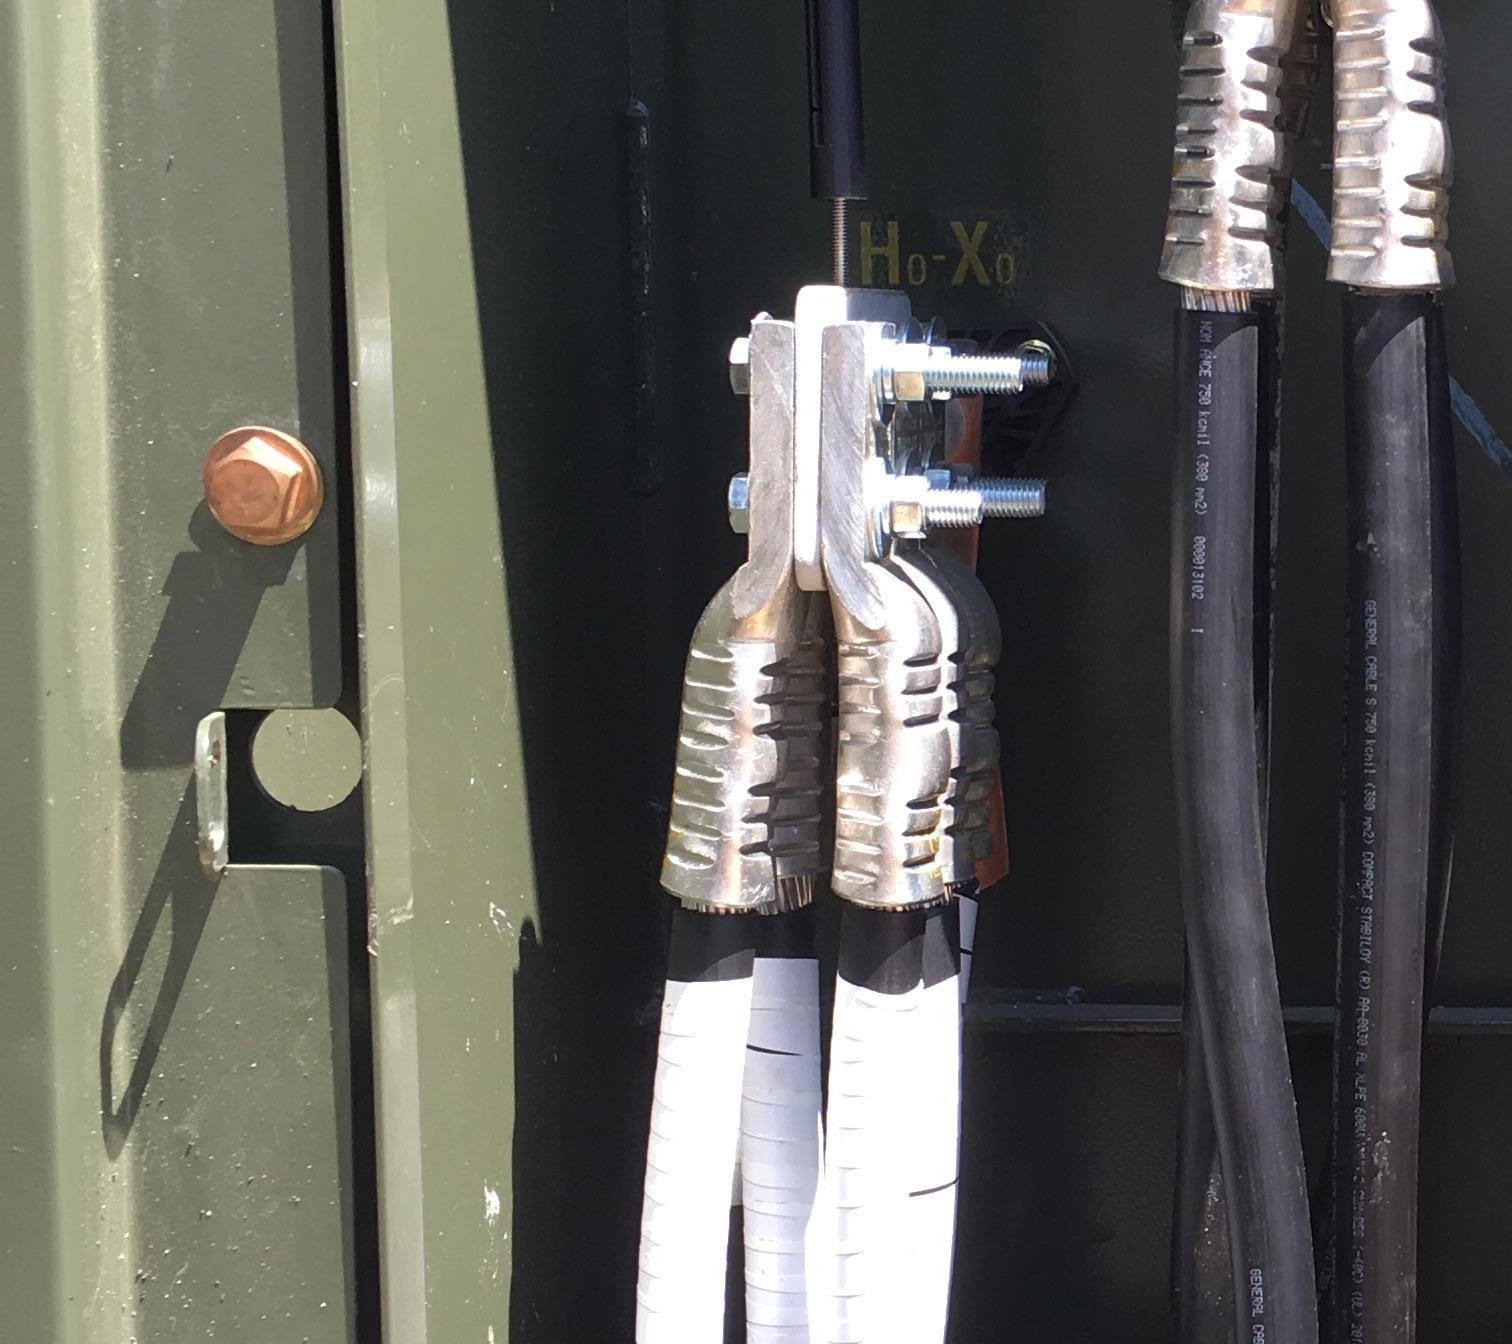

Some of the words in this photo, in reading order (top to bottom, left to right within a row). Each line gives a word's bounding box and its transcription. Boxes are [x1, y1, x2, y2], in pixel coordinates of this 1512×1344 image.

[1198, 383, 1211, 405] 750
[1365, 599, 1377, 650] GENERAL
[1365, 711, 1377, 734] 750
[1361, 851, 1375, 901] COMPACT
[1250, 1268, 1264, 1317] GENERAL
